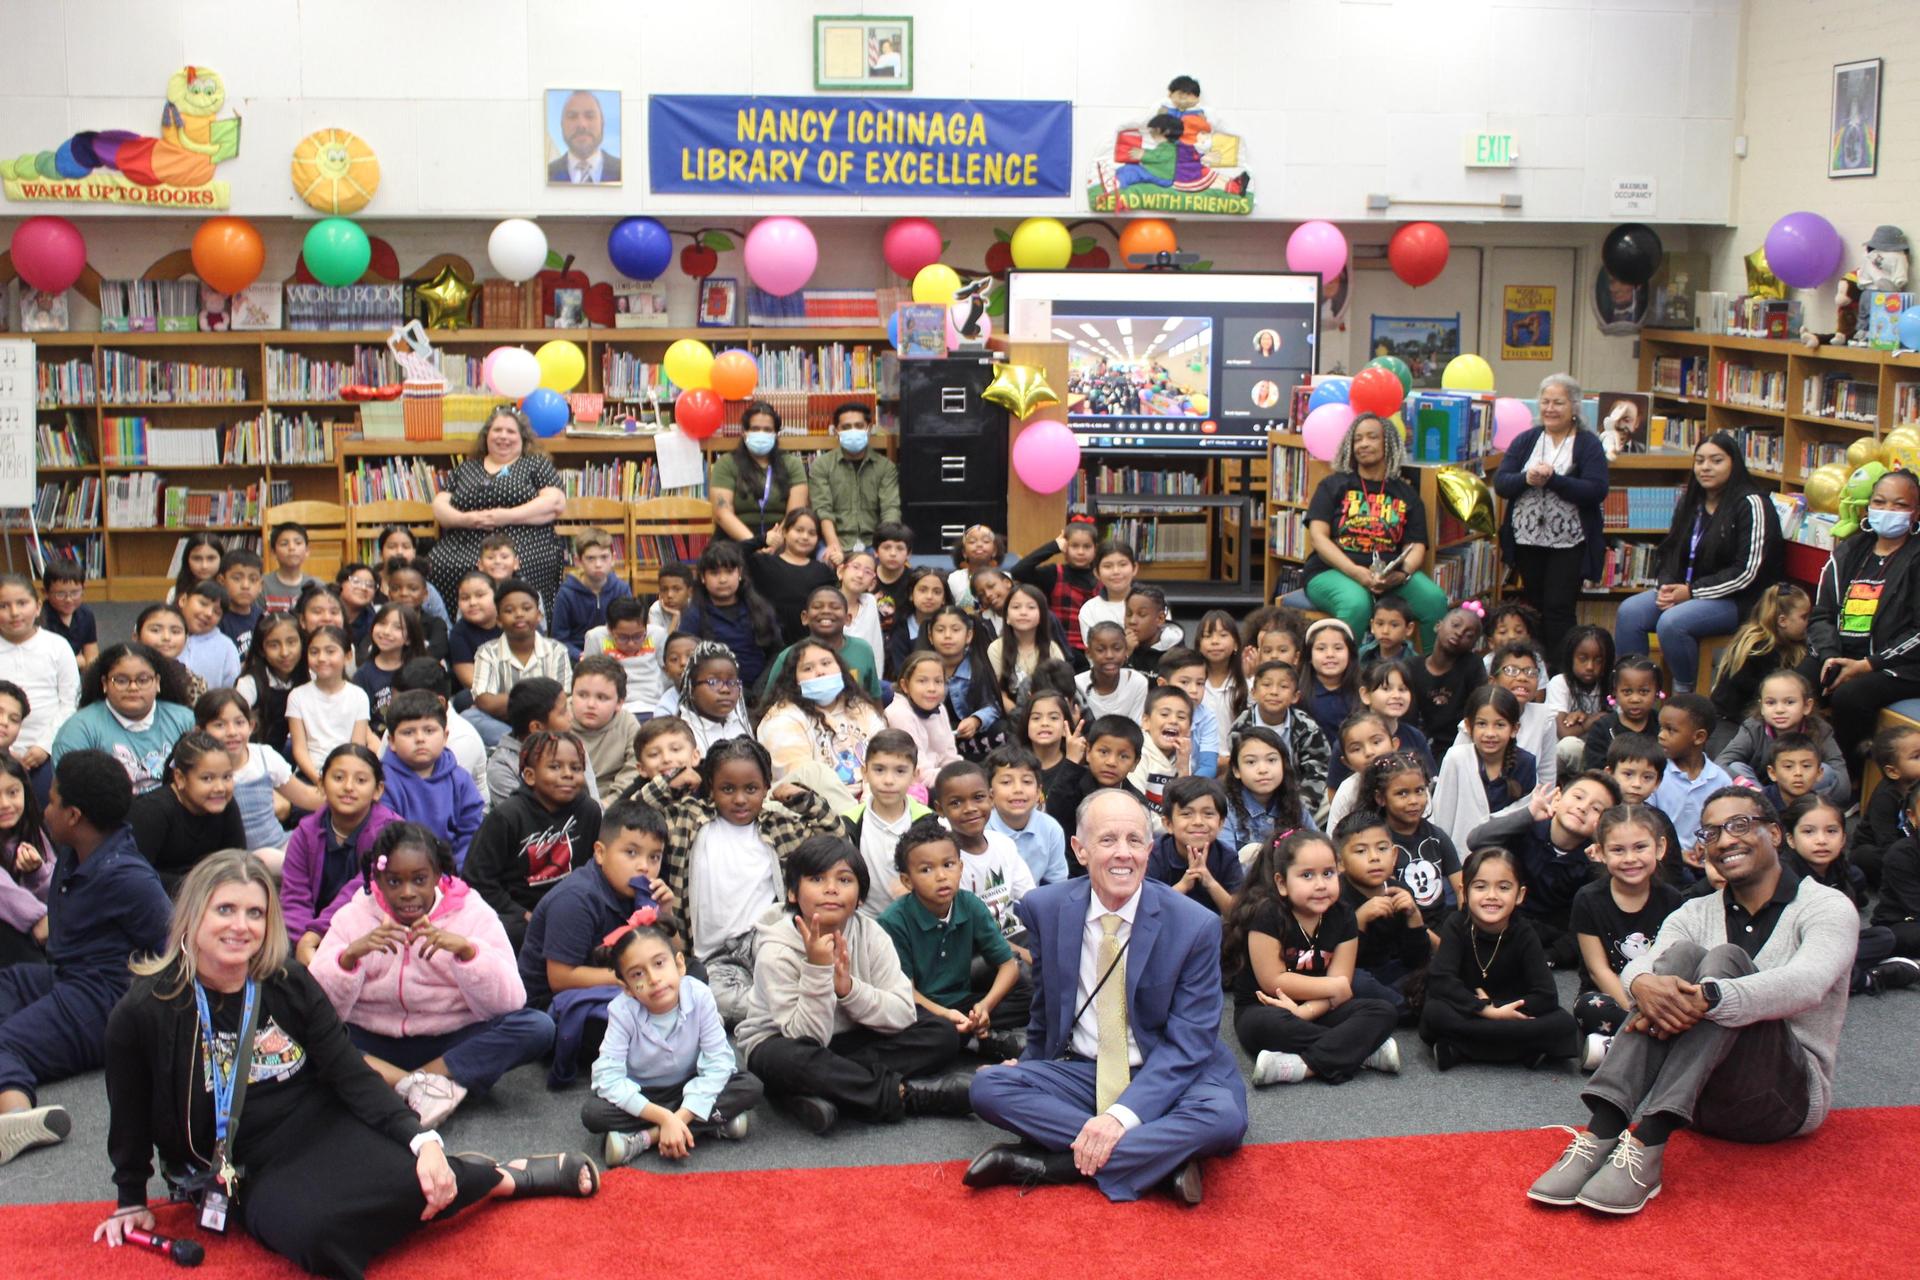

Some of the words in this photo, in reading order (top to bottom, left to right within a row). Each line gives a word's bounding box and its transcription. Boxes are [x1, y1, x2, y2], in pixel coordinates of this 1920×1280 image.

[736, 108, 838, 143] NANCY
[847, 109, 987, 146] ICHINAGA
[1476, 134, 1512, 164] EXIT
[682, 147, 809, 183] LIBRARY
[817, 151, 854, 184] OF
[865, 151, 1039, 186] EXCELLENCE
[21, 183, 82, 199] WARM
[88, 183, 114, 200] UP
[115, 185, 143, 201] TO
[147, 187, 215, 206] BOOKS
[1614, 190, 1653, 199] OCCUPANCY
[1618, 182, 1649, 190] MAXIMUM
[1095, 194, 1140, 211] READ
[1142, 194, 1181, 209] WITH
[1184, 195, 1250, 213] FRIENDS
[287, 286, 351, 302] WORLD
[354, 286, 402, 302] BOOK
